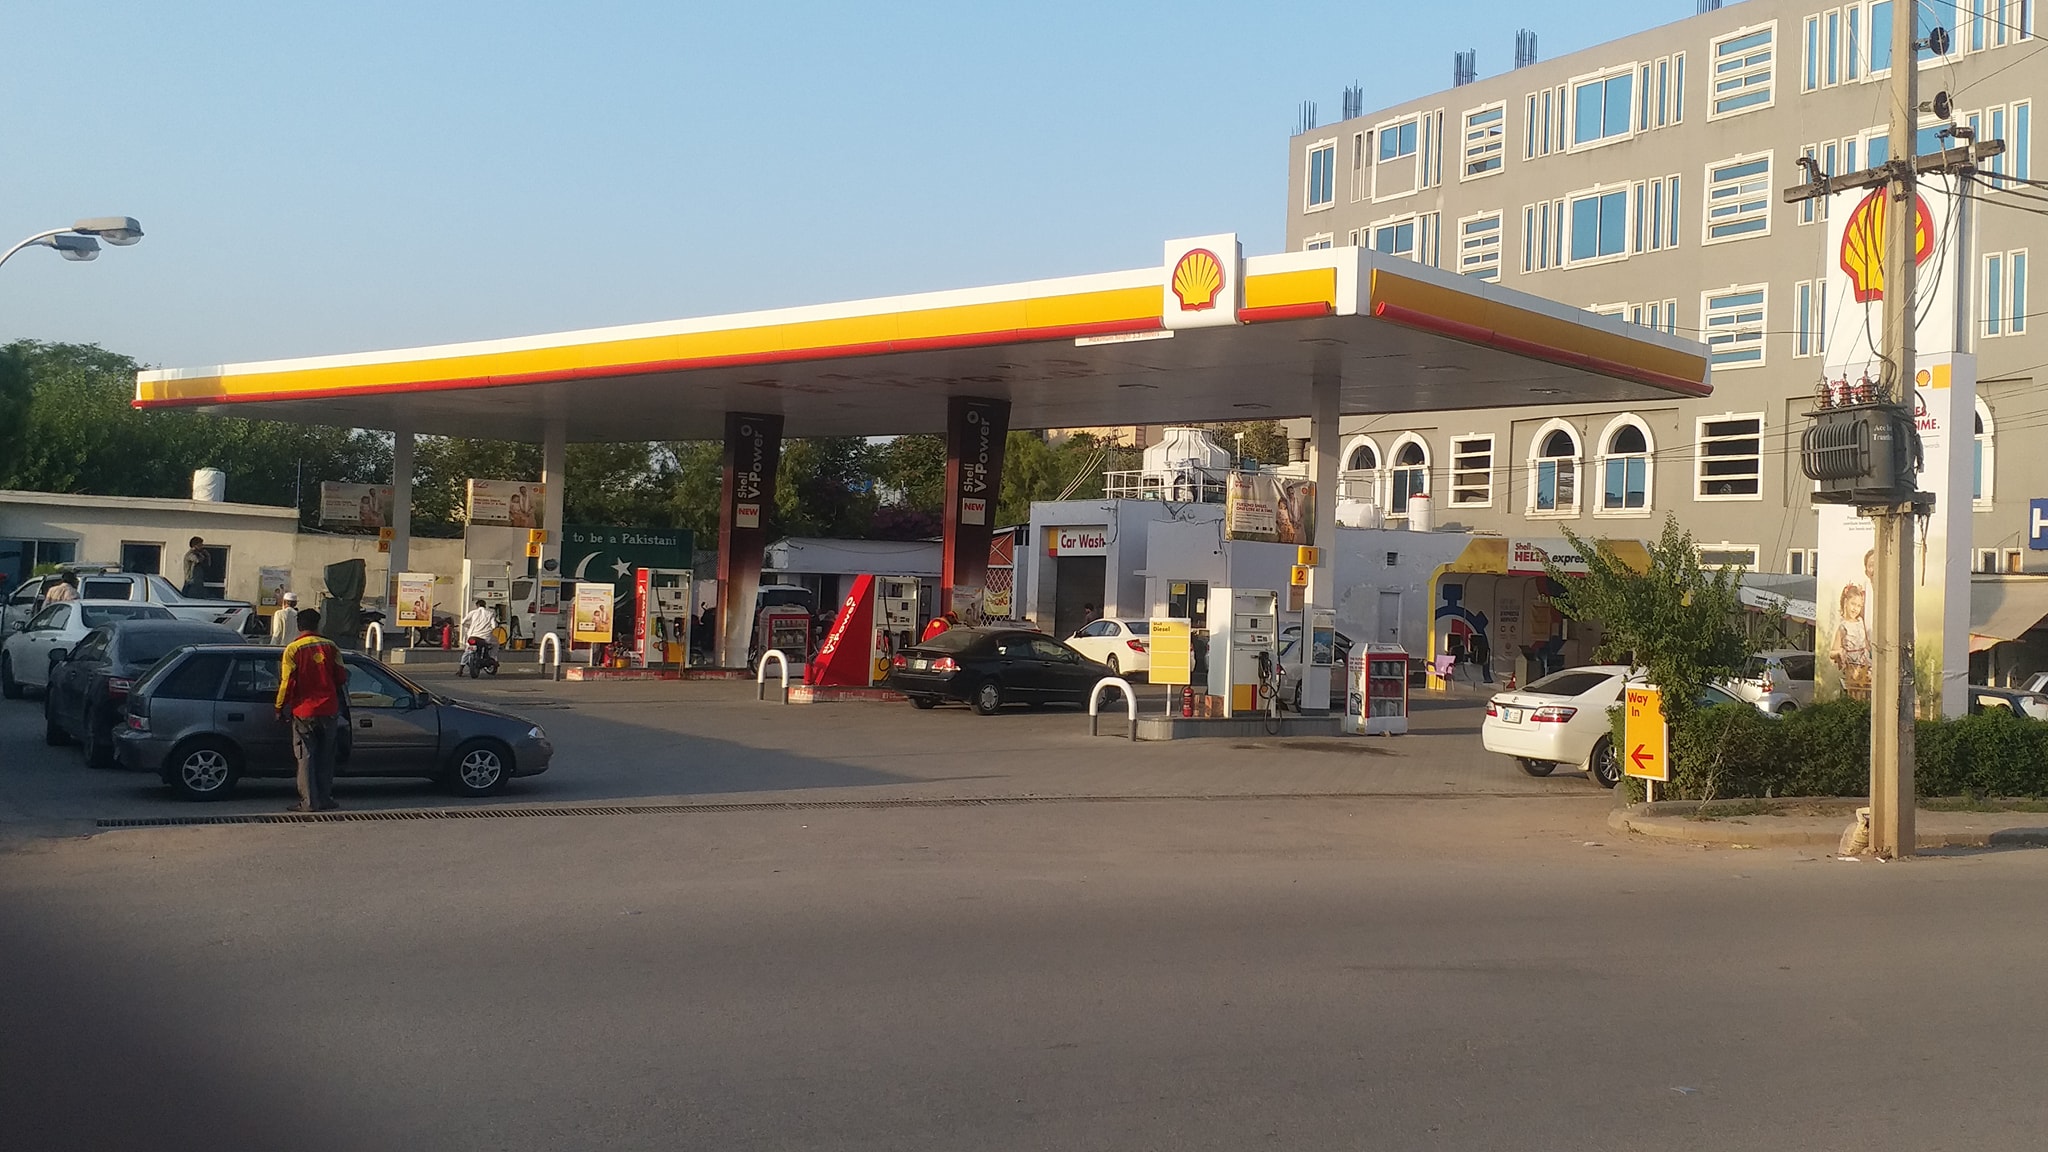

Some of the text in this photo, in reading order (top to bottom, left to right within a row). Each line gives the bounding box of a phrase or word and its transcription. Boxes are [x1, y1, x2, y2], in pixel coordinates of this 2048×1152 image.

[974, 417, 990, 493] V-Power
[748, 430, 764, 499] V-Power
[963, 463, 974, 493] Shell
[737, 472, 748, 499] Shell
[738, 507, 758, 516] NEW
[964, 502, 984, 511] NEW
[536, 532, 542, 540] 7
[573, 532, 584, 543] to
[590, 532, 603, 543] be
[622, 533, 677, 546] Pakistani
[1061, 532, 1105, 549] Car Wash
[530, 545, 537, 554] 8
[1515, 543, 1532, 551] Shell
[1297, 570, 1305, 581] 2
[1628, 692, 1649, 706] Way
[1631, 706, 1640, 717] In
